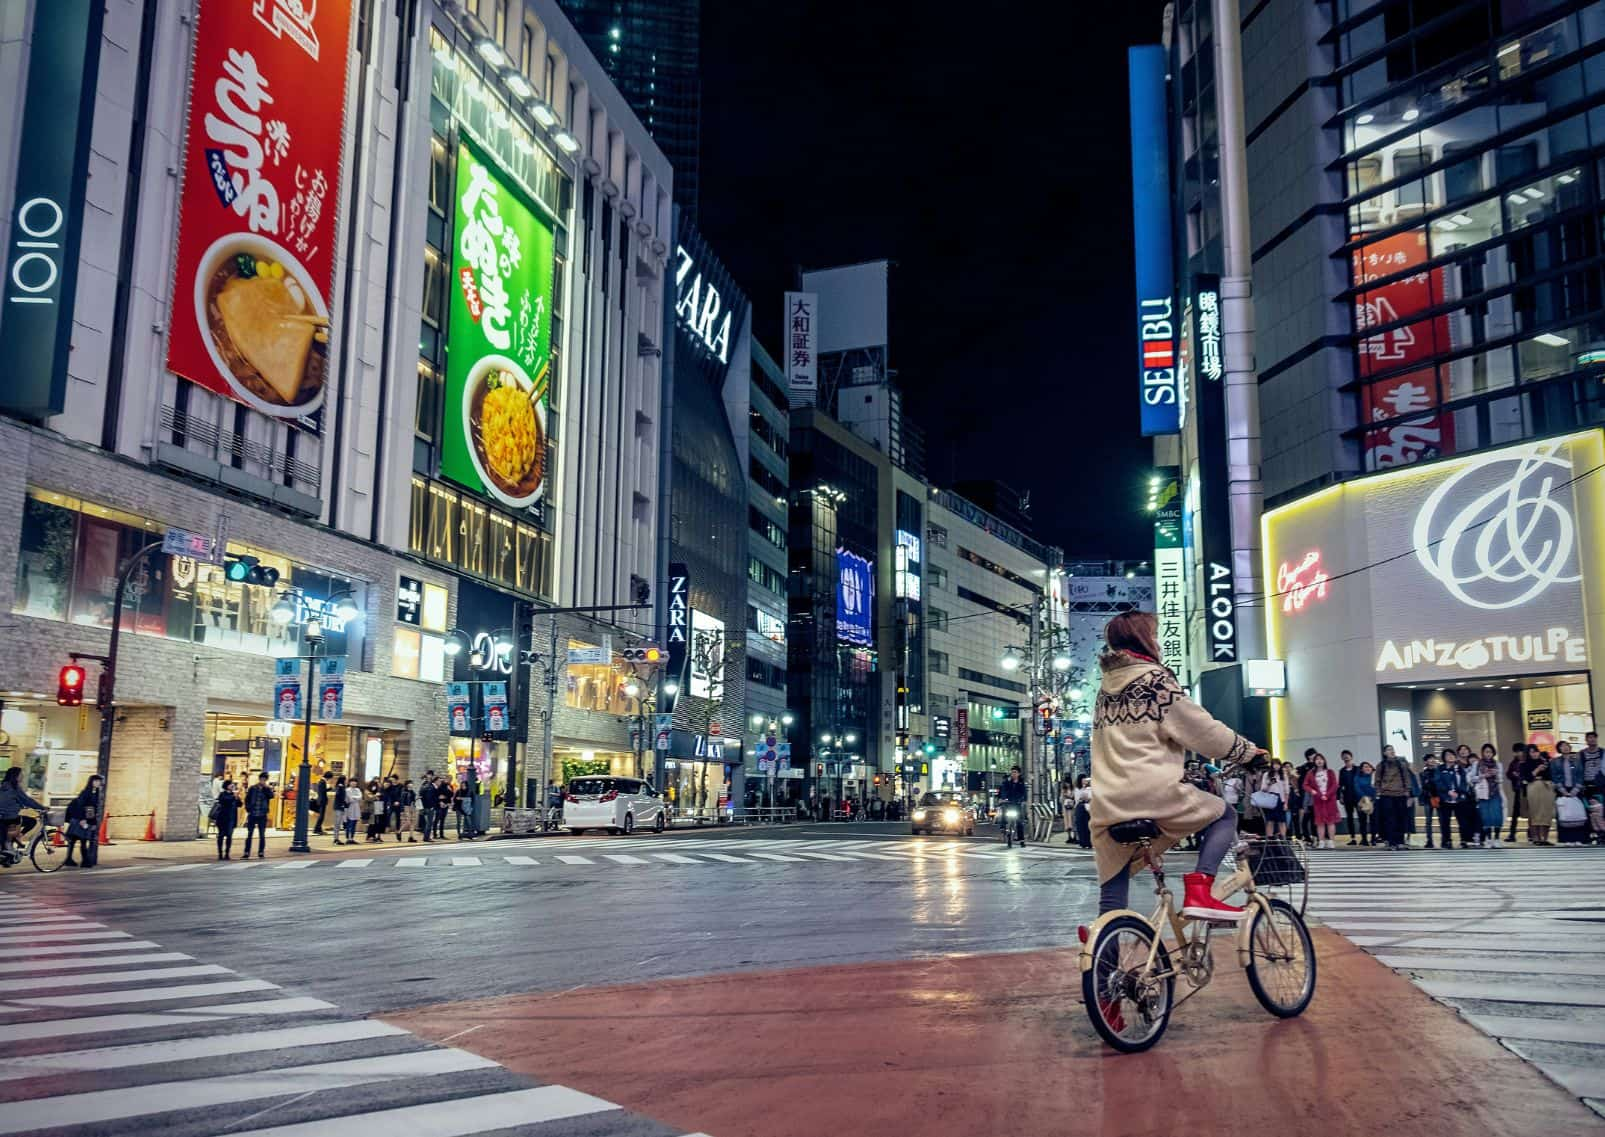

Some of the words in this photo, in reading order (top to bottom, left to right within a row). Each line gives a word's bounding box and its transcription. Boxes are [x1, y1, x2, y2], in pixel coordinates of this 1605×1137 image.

[205, 47, 279, 236] きつね
[265, 119, 291, 166] 赤い
[460, 162, 513, 350] たぬき
[791, 299, 811, 367] 大和証券
[1141, 296, 1176, 405] SEIBU
[1199, 291, 1223, 381] 眼鏡市場
[1155, 509, 1181, 519] SMBC
[668, 577, 687, 642] ZARA
[1160, 561, 1183, 677] 三井住友銀行
[1210, 562, 1235, 659] ALOOK
